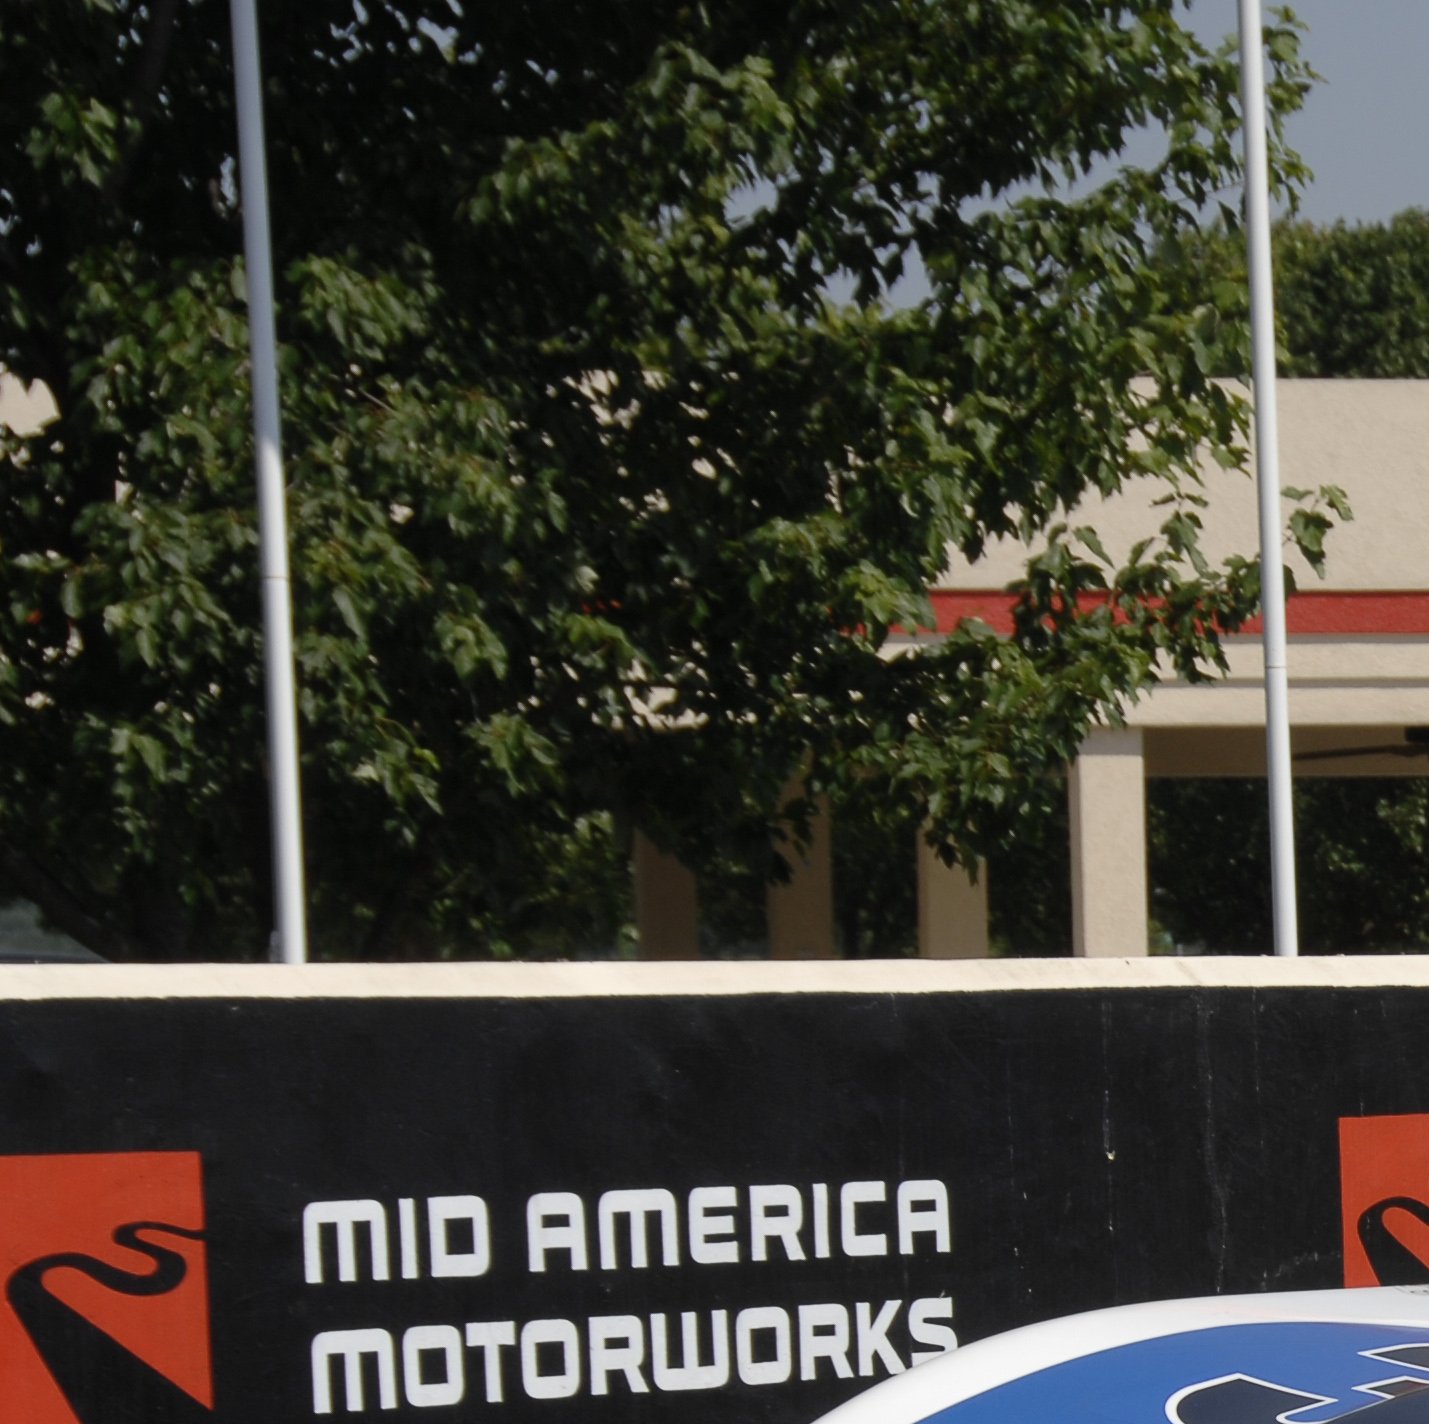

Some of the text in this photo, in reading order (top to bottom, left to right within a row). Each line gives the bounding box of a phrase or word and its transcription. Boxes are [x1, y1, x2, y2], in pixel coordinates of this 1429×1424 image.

[303, 1179, 952, 1283] MID AMERICA
[311, 1297, 958, 1415] MOTORWORKS
